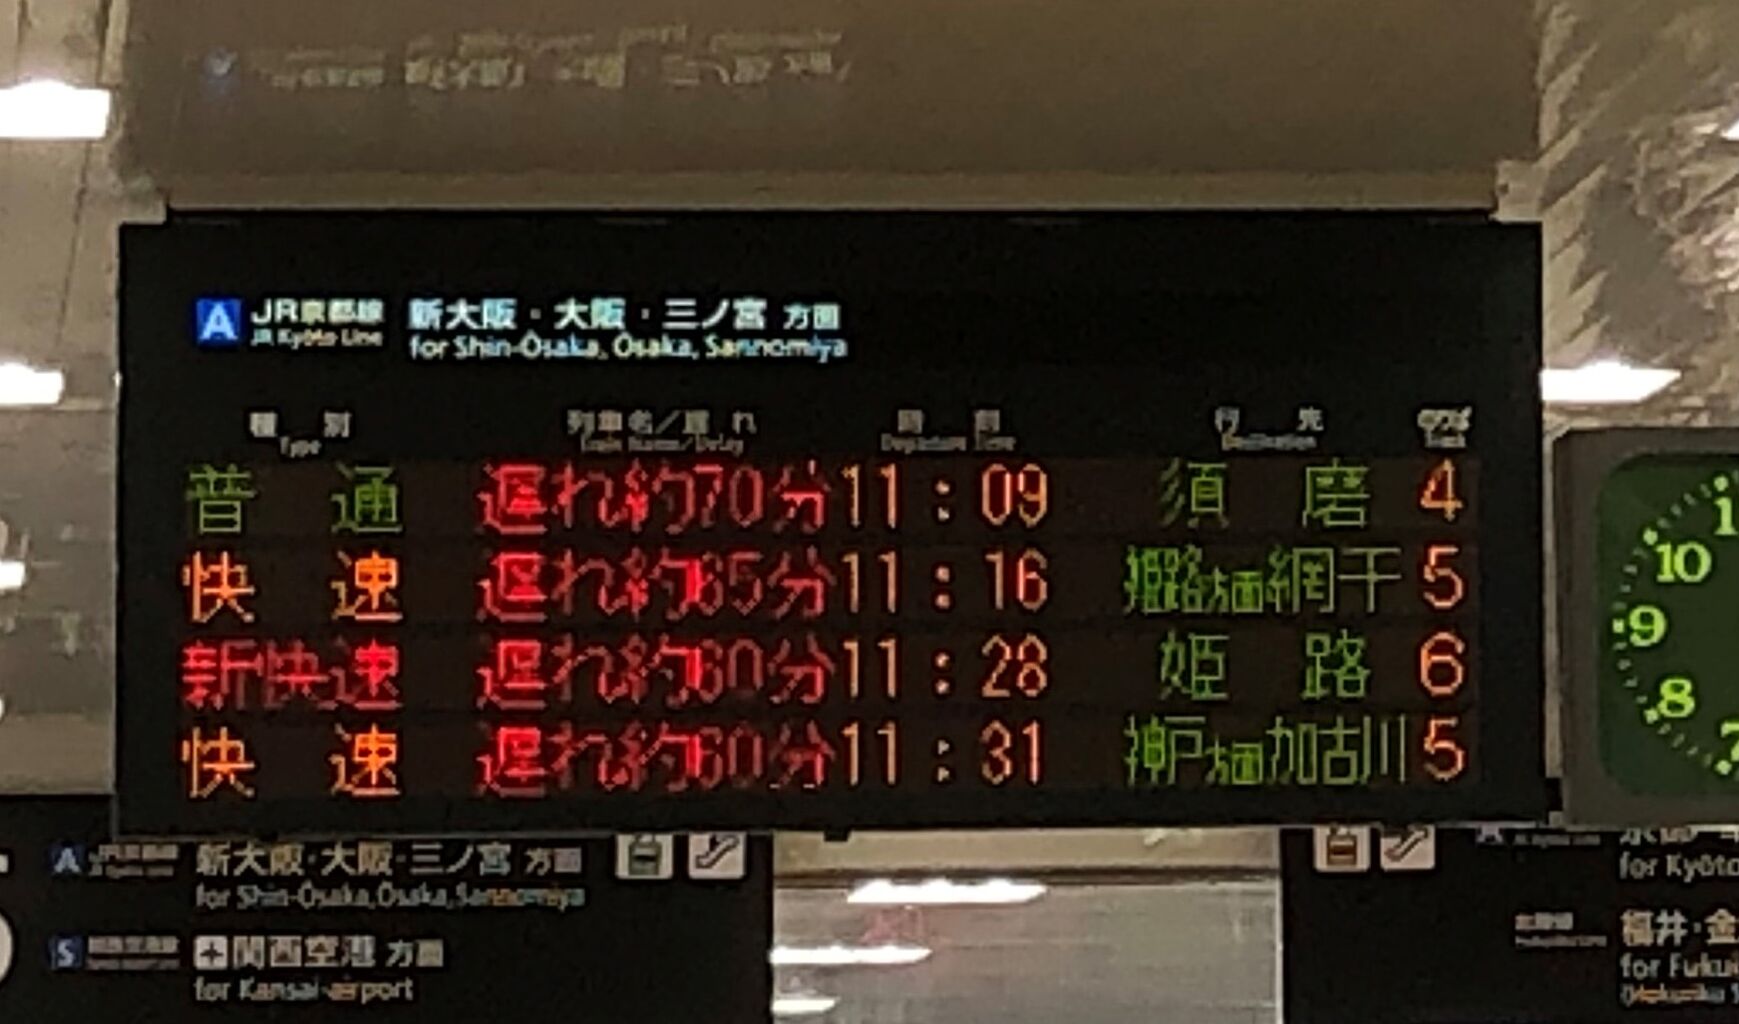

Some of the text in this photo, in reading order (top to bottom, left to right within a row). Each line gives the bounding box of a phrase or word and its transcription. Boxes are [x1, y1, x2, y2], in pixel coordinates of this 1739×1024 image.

[201, 304, 238, 339] A
[408, 297, 840, 330] 新大阪・大阪・三ノ宮 方面
[409, 335, 448, 360] for
[1418, 458, 1463, 523] 4
[1421, 545, 1464, 609] 5
[1654, 542, 1712, 584] 10
[1628, 604, 1667, 648] 9
[182, 636, 404, 711] 新快速
[1418, 631, 1465, 697] 6
[1658, 677, 1696, 718] 8
[1421, 717, 1466, 782] 5
[54, 847, 81, 874] A
[1619, 853, 1657, 880] for
[1620, 954, 1658, 978] for
